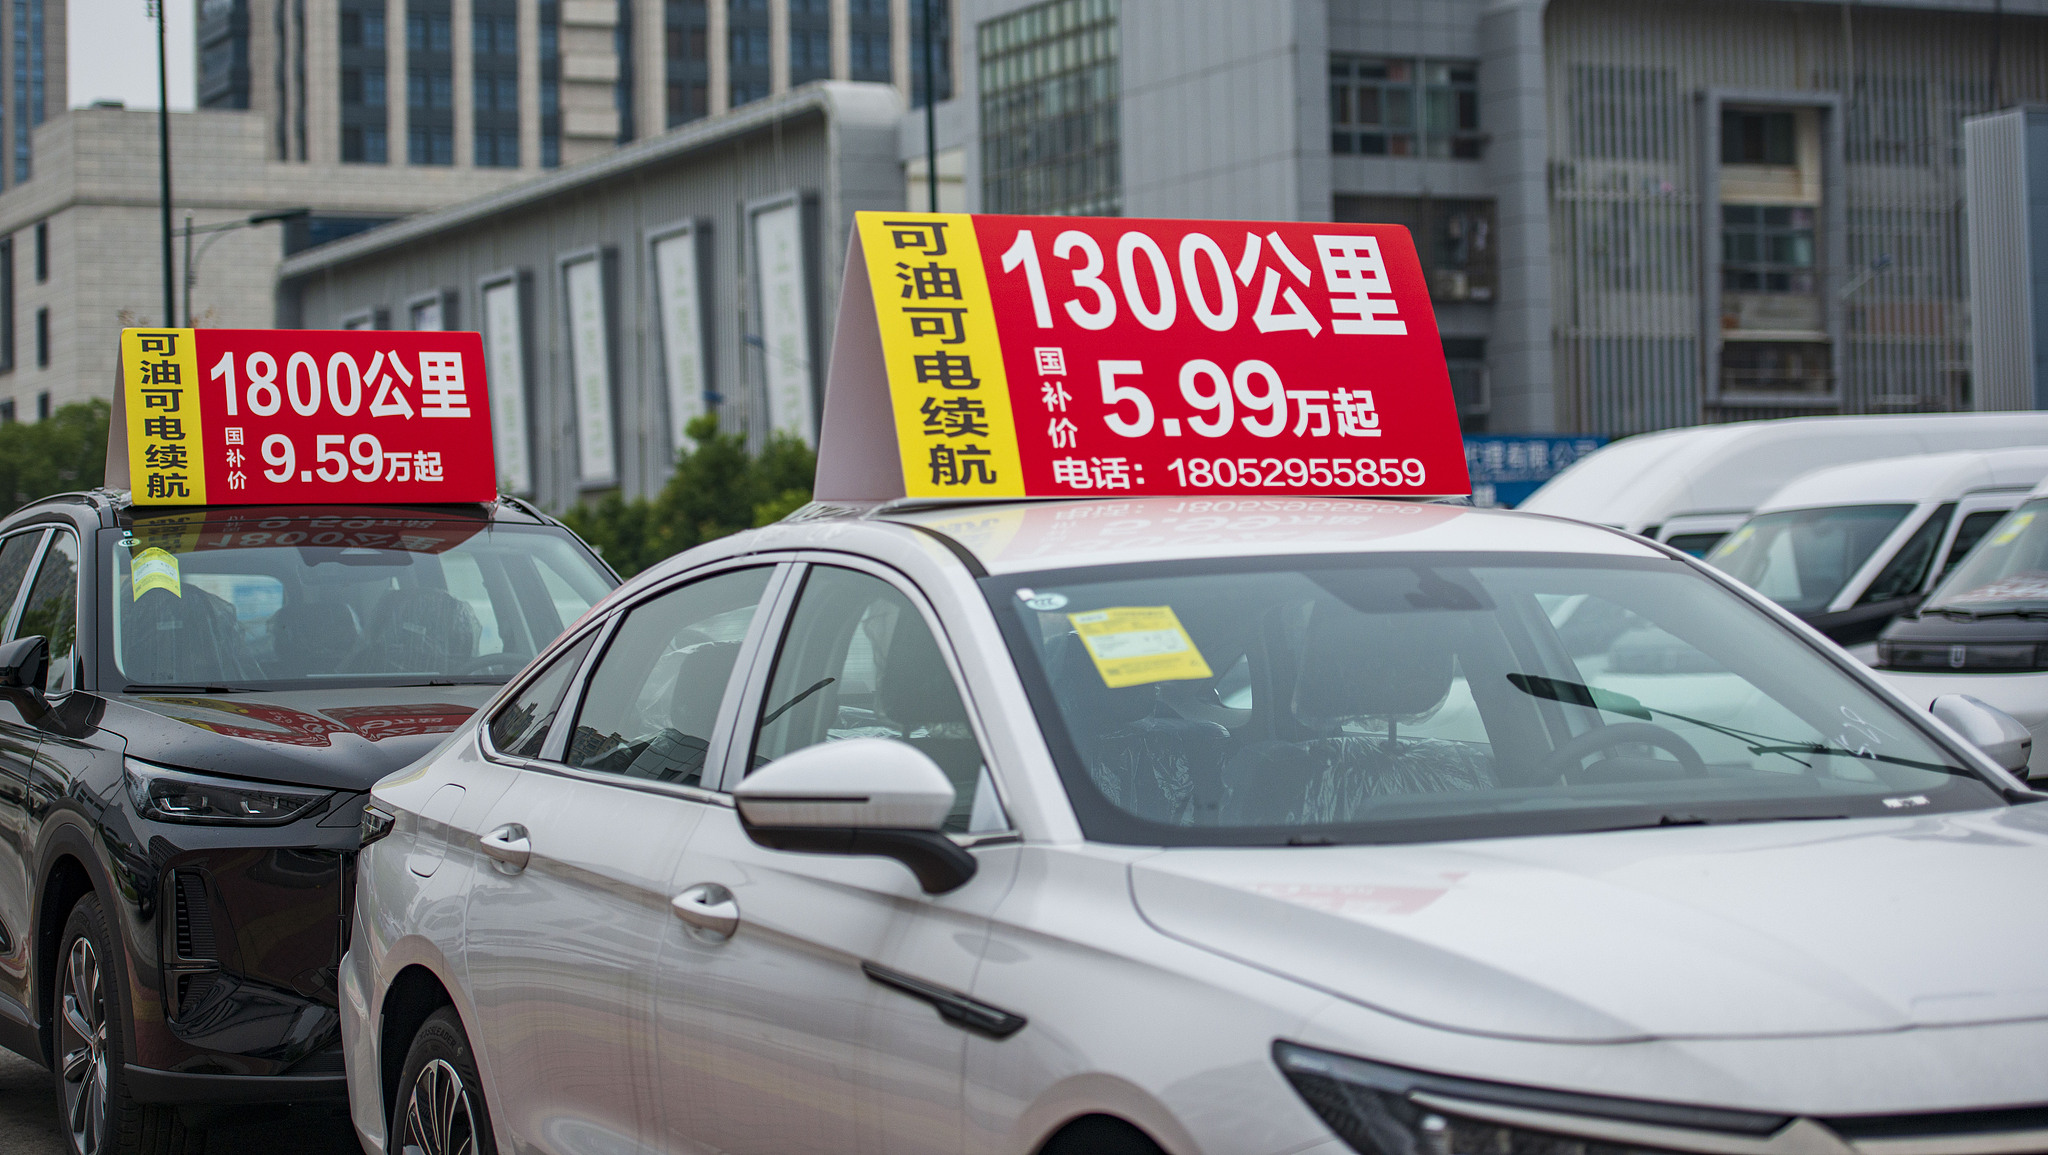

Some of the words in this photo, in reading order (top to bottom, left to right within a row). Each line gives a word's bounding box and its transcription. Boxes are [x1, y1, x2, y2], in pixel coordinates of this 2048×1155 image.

[1001, 229, 1407, 338] 1300公里
[211, 350, 470, 420] 1800公里
[883, 221, 997, 488] 可油可电续航
[137, 333, 189, 498] 可油可电续航
[1034, 347, 1078, 448] 国补价
[1098, 359, 1381, 438] 5.99万起
[225, 427, 247, 490] 国补价
[262, 434, 443, 483] 9.59万起
[1168, 457, 1426, 488] 18052955859
